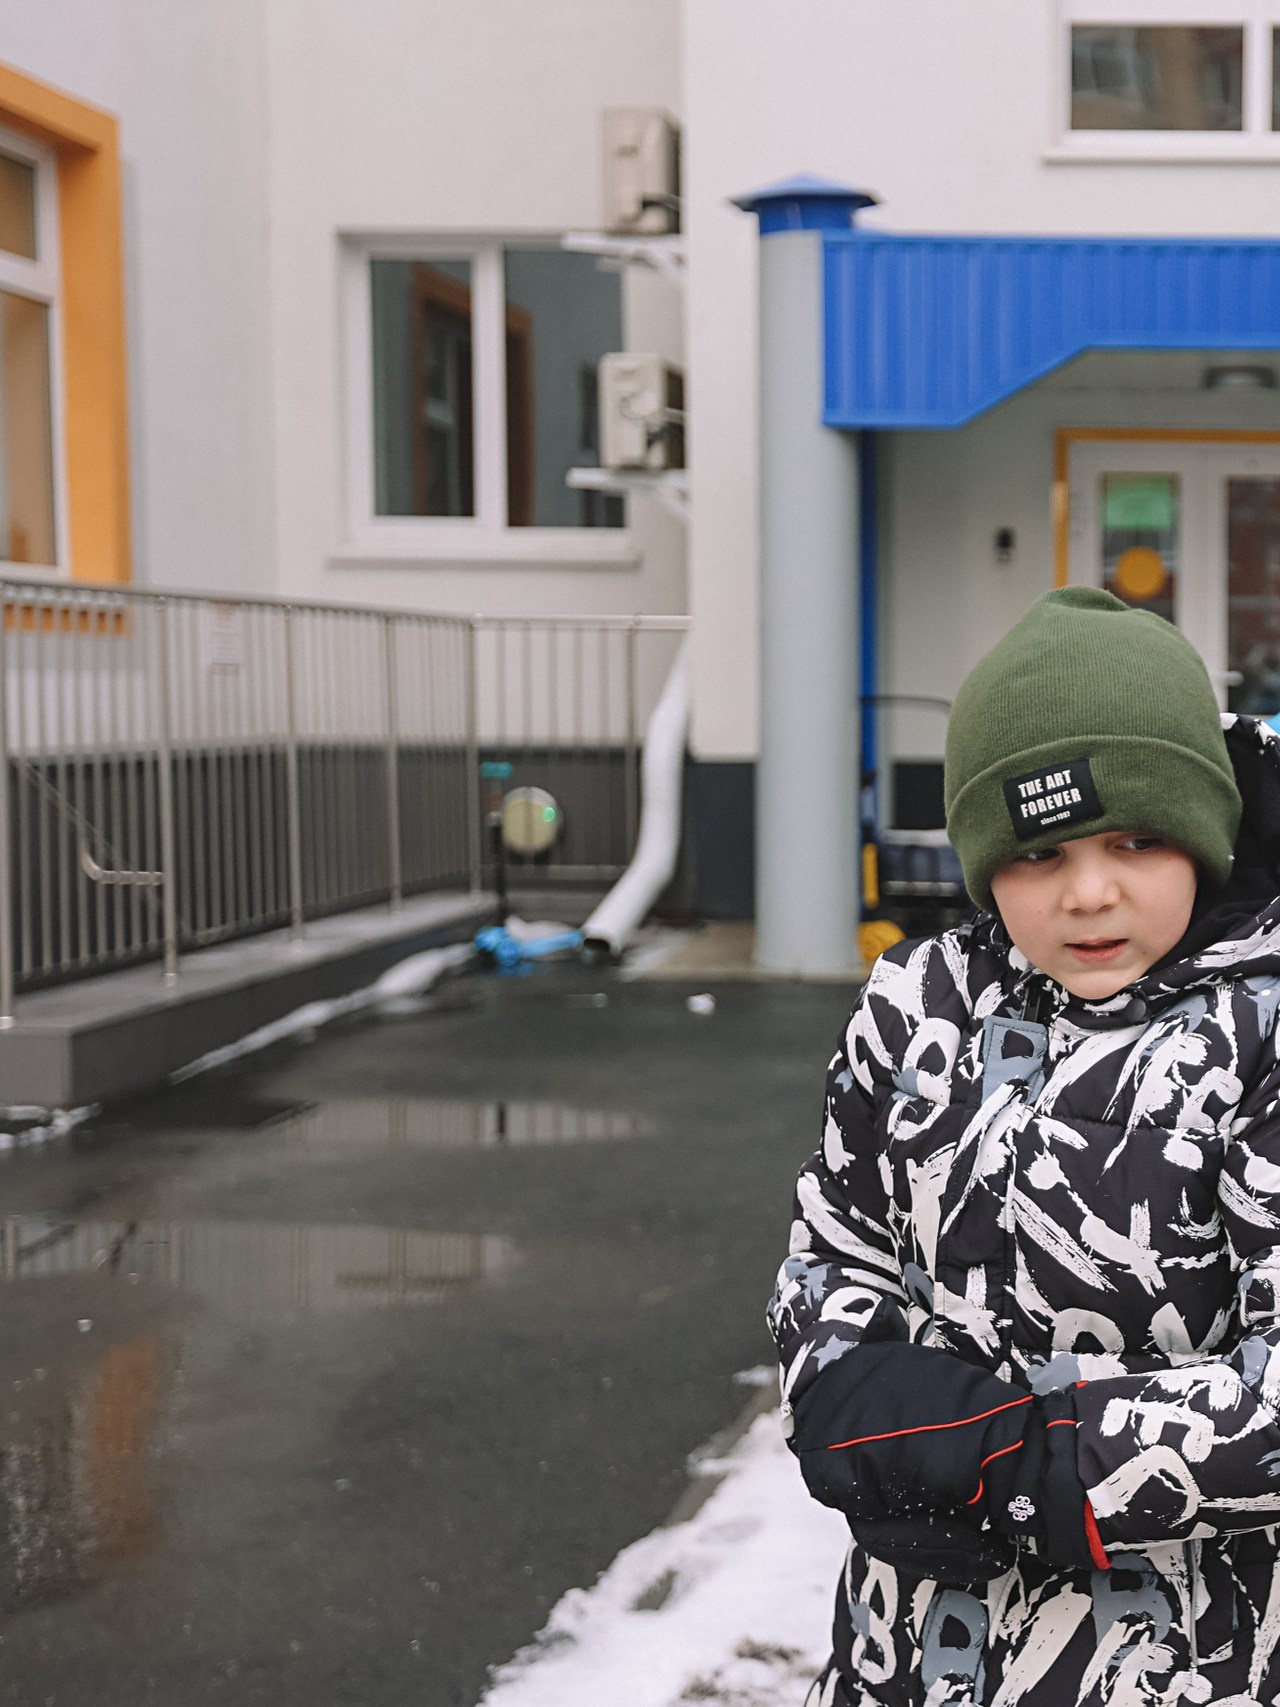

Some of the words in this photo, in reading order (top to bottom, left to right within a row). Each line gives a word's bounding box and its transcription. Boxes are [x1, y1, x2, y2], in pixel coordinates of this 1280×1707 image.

[1018, 779, 1044, 798] THE
[1045, 770, 1072, 790] ART
[1020, 787, 1082, 818] FOREVER
[1040, 815, 1057, 825] since
